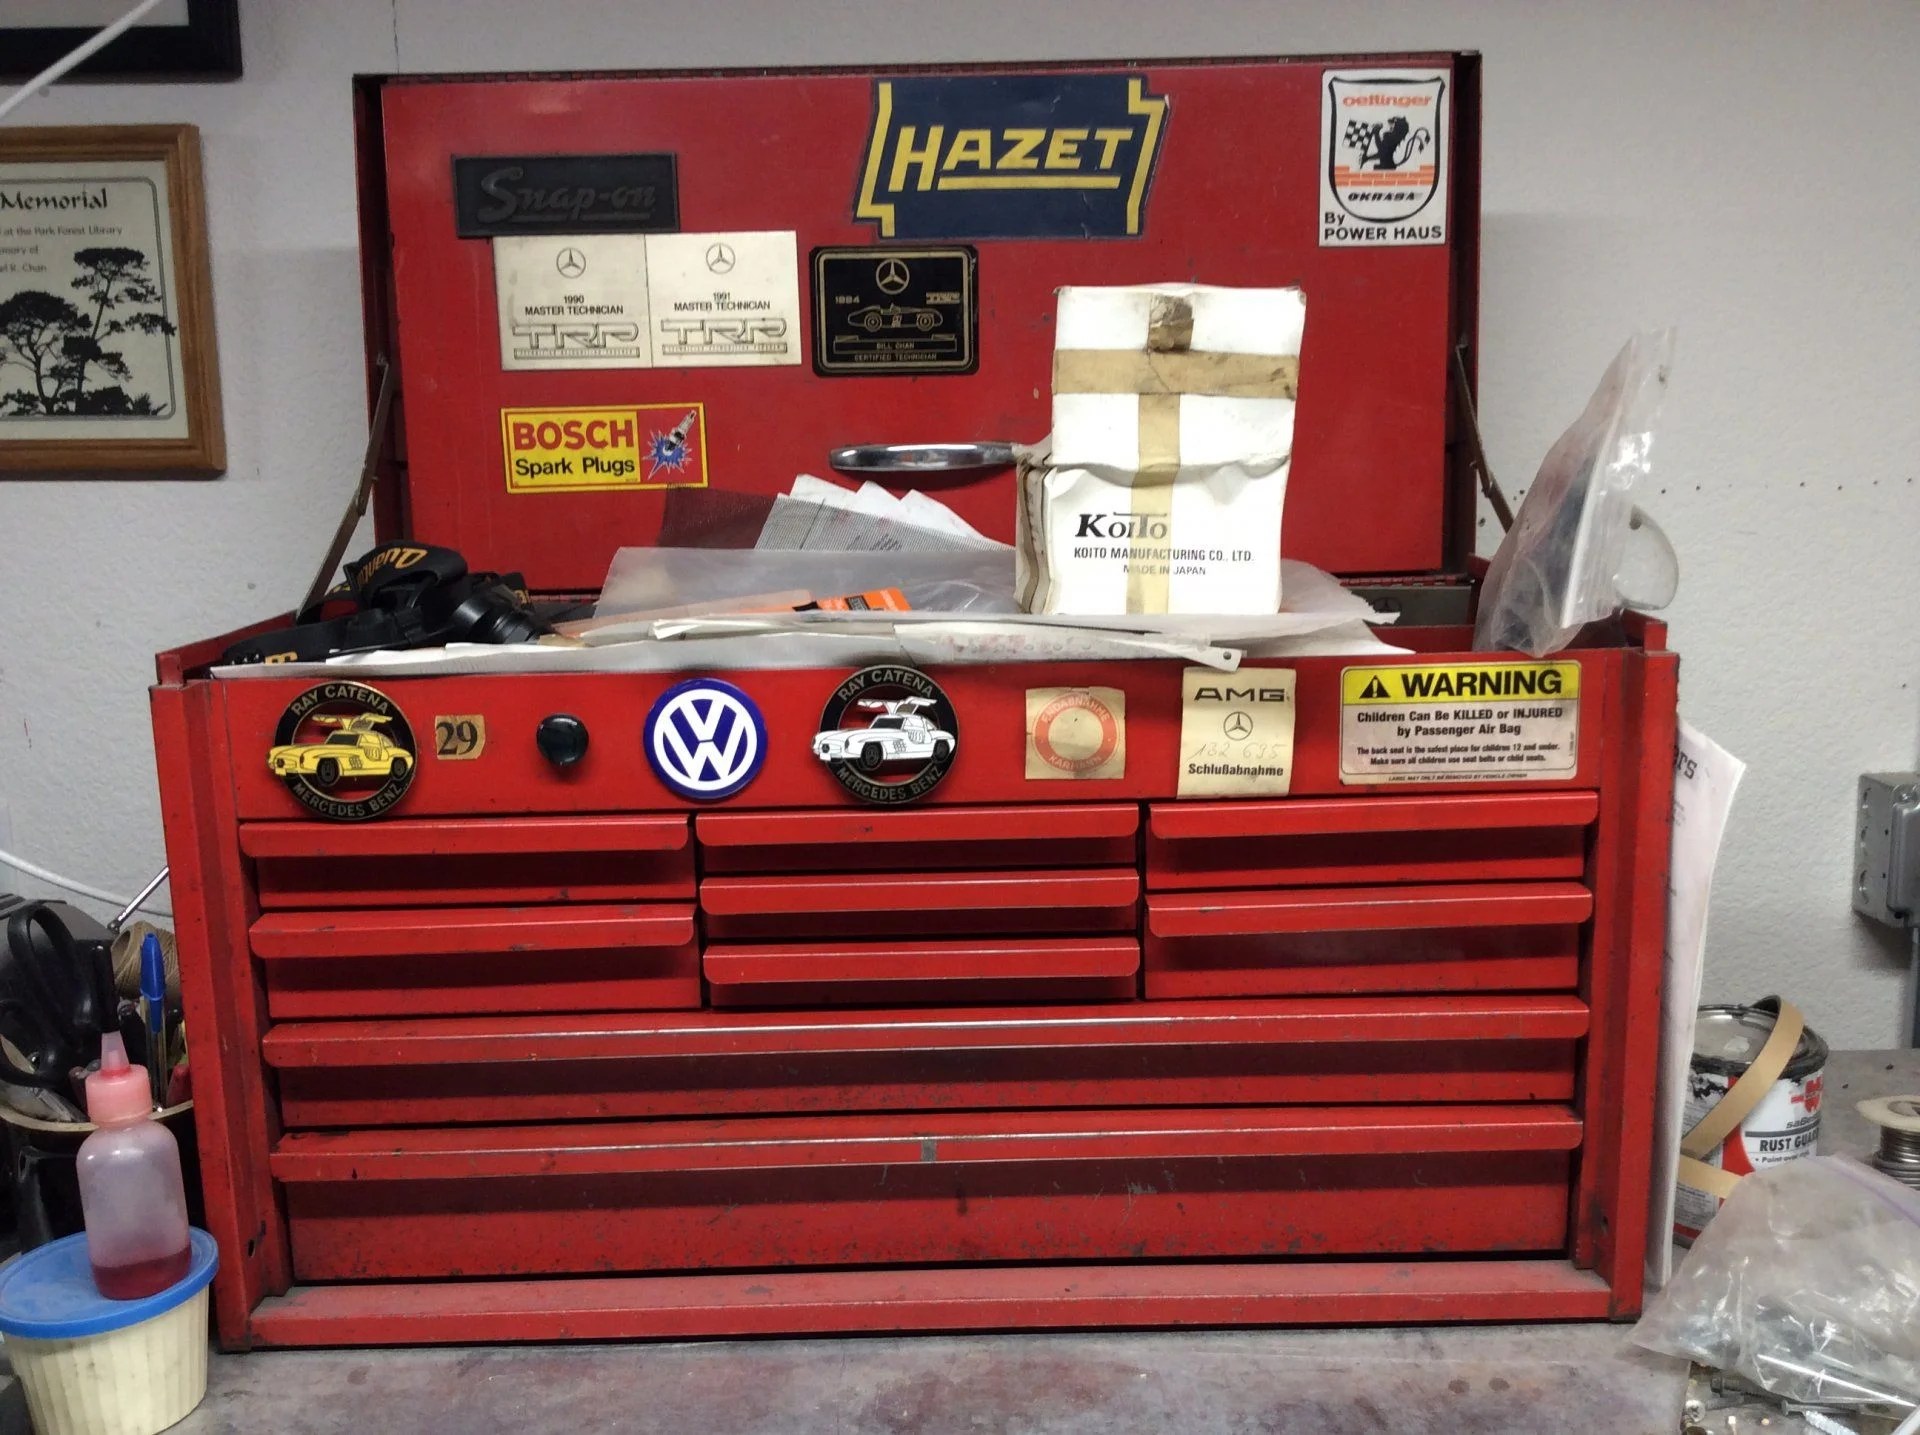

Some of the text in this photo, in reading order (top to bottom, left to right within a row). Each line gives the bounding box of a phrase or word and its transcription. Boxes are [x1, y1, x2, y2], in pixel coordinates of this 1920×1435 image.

[888, 125, 1133, 192] HAZET
[0, 186, 108, 210] Memorial
[477, 166, 656, 223] Snap-on
[1325, 212, 1346, 226] By
[88, 225, 122, 237] Library
[1324, 226, 1442, 241] POWER HAUS
[564, 294, 585, 304] 1990
[713, 292, 731, 301] 1991
[525, 304, 624, 316] MASTER TECHNICIAN
[674, 300, 771, 312] MASTER TECHNICIAN
[513, 420, 635, 451] BOSCH
[515, 456, 635, 479] Spark Plugs
[1074, 547, 1107, 559] KOITO
[1110, 548, 1206, 561] MANUFACTURING
[1232, 550, 1254, 562] LTD.
[1159, 565, 1170, 575] IN
[1173, 566, 1206, 576] JAPAN
[838, 670, 934, 701] RAY CATENA
[1402, 669, 1562, 698] WARNING
[291, 686, 388, 716] RAY CATENA
[1194, 688, 1285, 702] AMG
[1358, 708, 1563, 723] Children Can Be KILLED or INJURED
[436, 721, 478, 756] 29
[1397, 724, 1522, 738] by Passenger Air Bag
[654, 689, 757, 792] VW
[1358, 746, 1369, 755] The
[1371, 746, 1388, 754] back
[1390, 746, 1404, 754] seat
[1406, 746, 1412, 754] is
[1414, 746, 1426, 754] the
[1428, 745, 1448, 753] safest
[1450, 745, 1468, 754] place
[1471, 744, 1480, 752] for
[1482, 744, 1510, 752] children
[1538, 742, 1560, 750] under.
[1418, 756, 1446, 764] children
[1506, 754, 1524, 762] child
[1677, 751, 1698, 779] TS
[1188, 763, 1284, 776] Schlußabnahme
[836, 766, 943, 799] MERCEDES BENZ
[292, 783, 403, 816] MERCEDES BENZ
[1760, 1127, 1820, 1151] RUST GUAR
